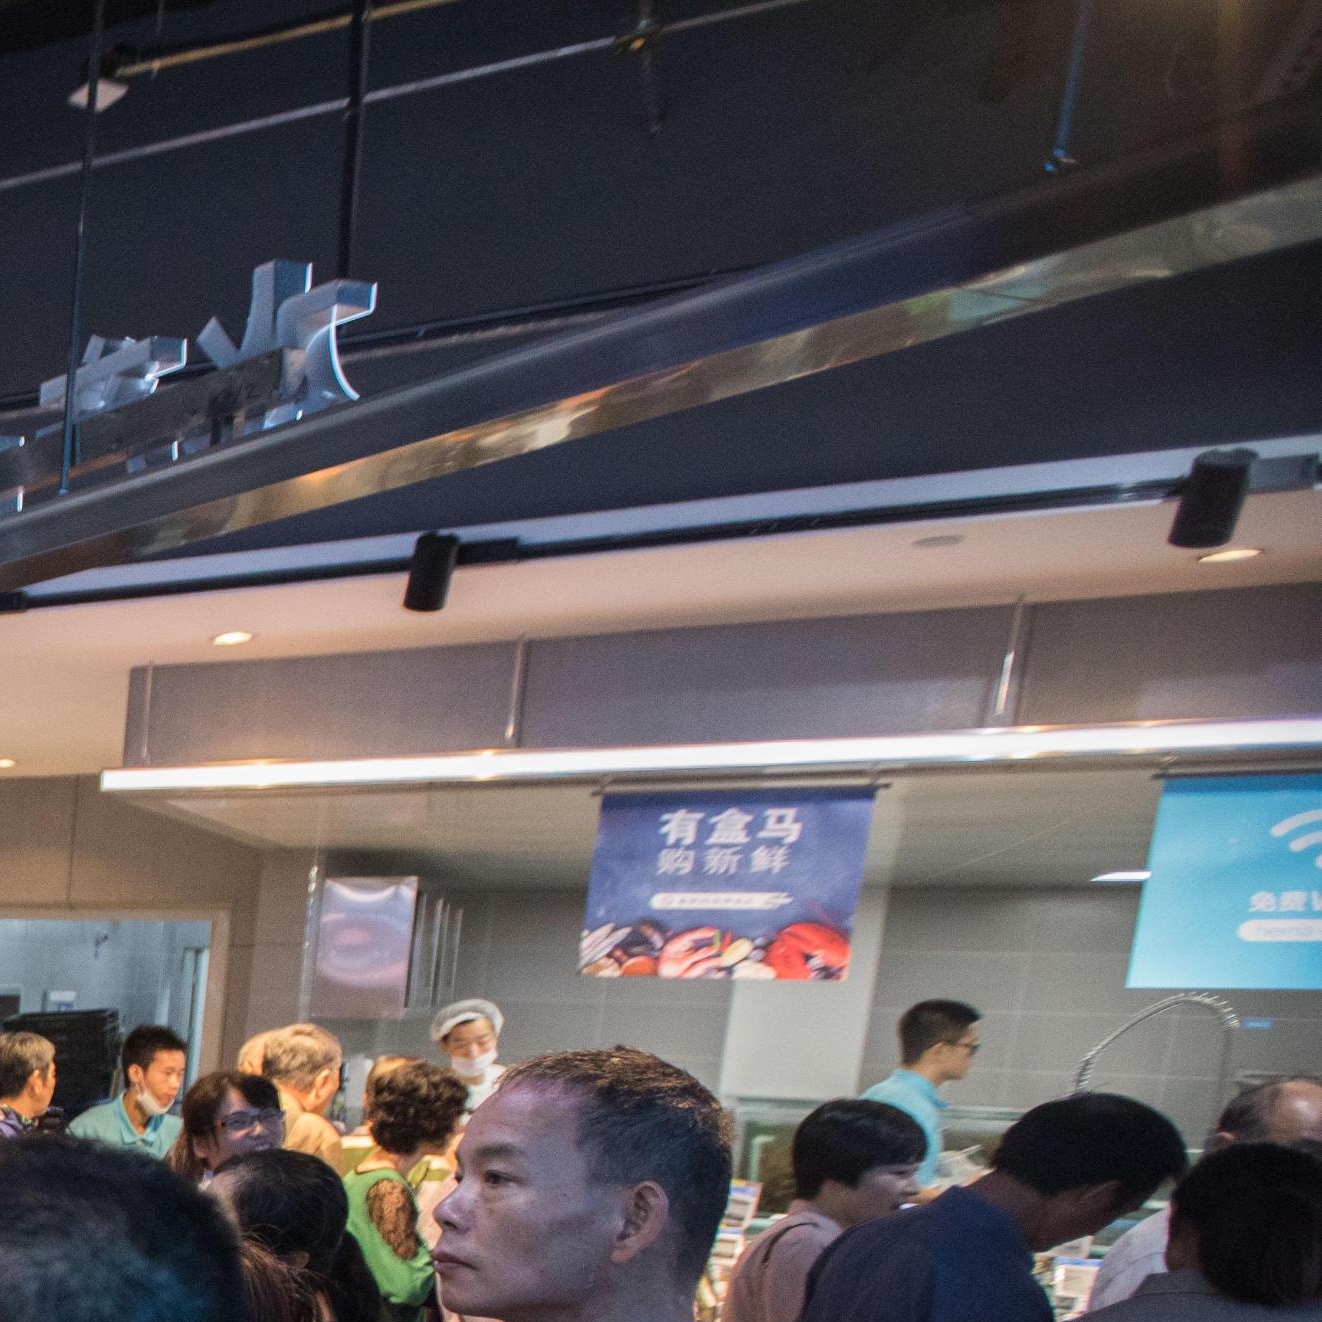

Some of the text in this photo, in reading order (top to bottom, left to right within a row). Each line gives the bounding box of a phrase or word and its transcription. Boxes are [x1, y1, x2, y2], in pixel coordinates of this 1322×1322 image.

[659, 807, 803, 846] 有盒马
[657, 845, 791, 876] 购新鲜
